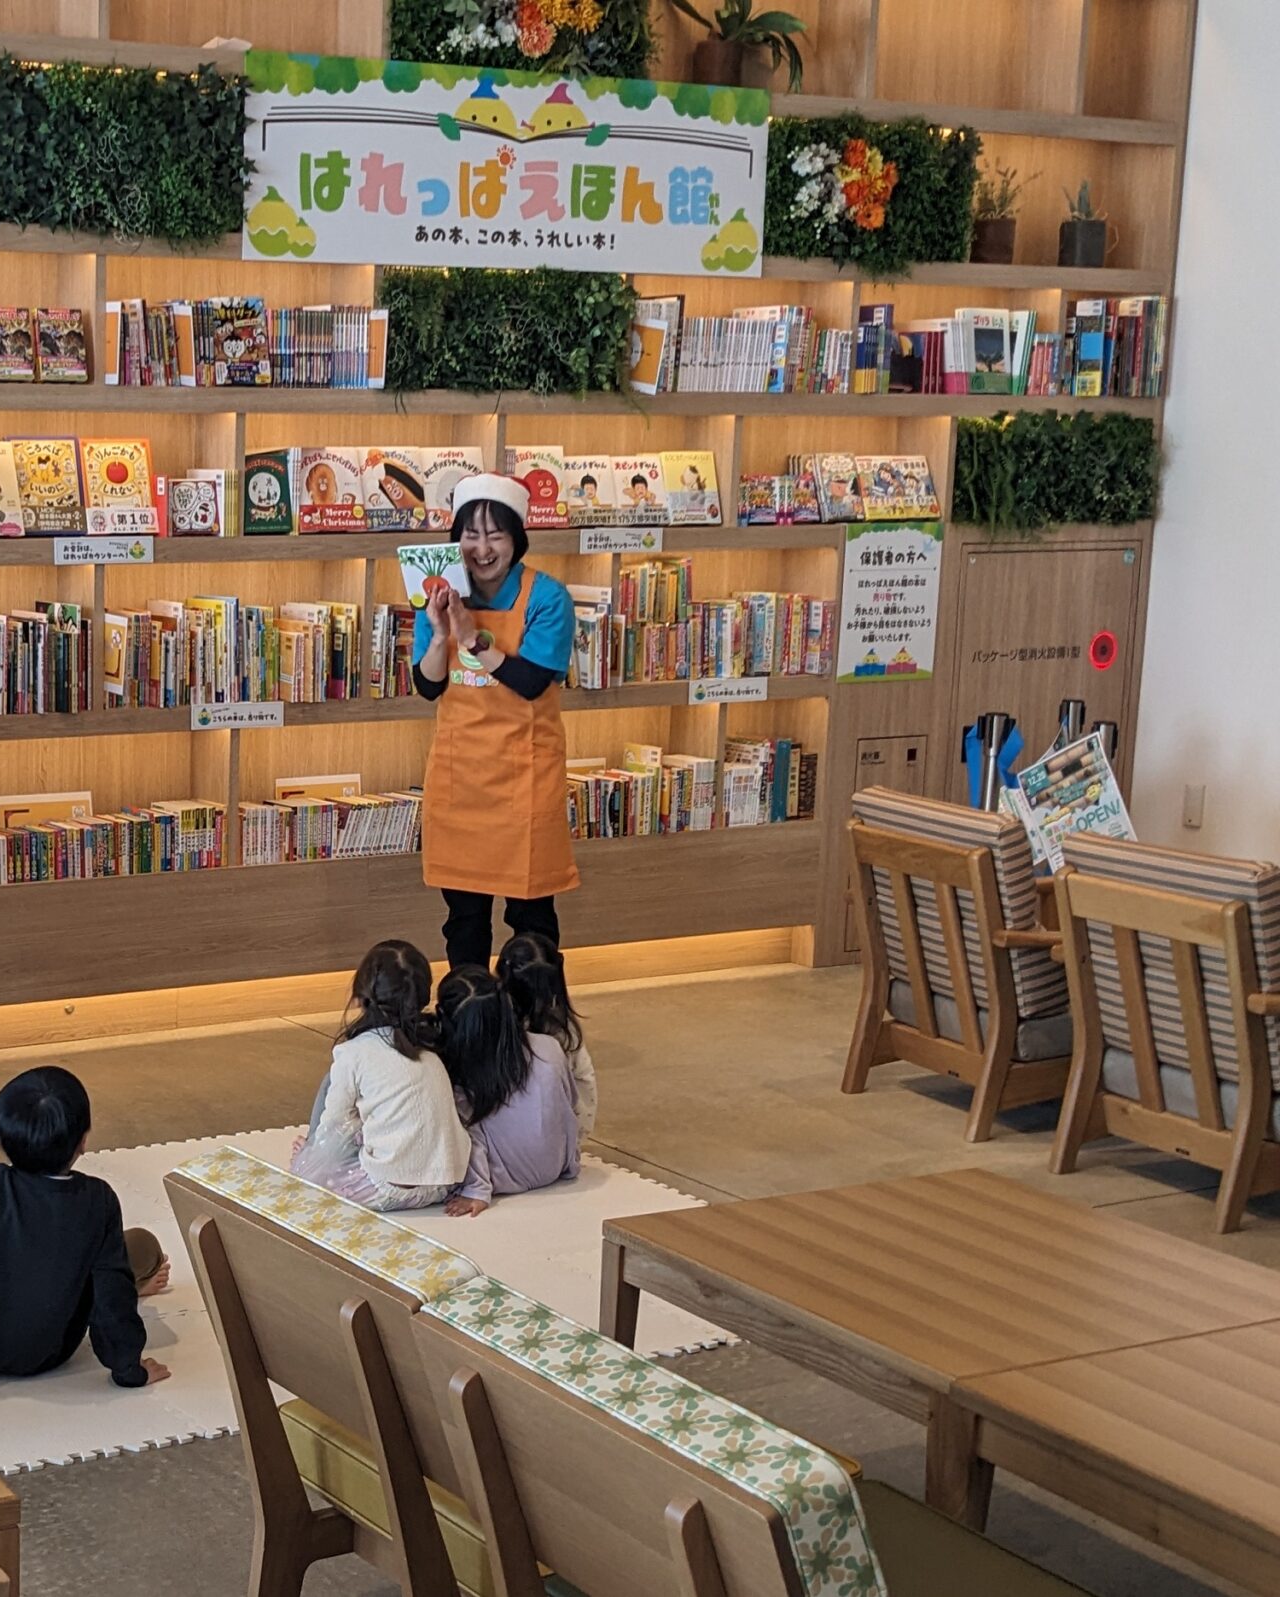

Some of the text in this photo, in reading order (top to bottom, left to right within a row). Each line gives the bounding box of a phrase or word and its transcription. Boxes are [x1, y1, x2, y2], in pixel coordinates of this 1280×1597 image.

[299, 144, 714, 226] はれっぱえほん館
[26, 443, 61, 456] ころべば
[95, 446, 136, 460] りんごかも
[564, 461, 607, 470] 大ピンチずかん
[615, 461, 658, 470] 大ピンチずかん
[30, 483, 65, 494] いいのに
[103, 484, 135, 495] しれない
[325, 508, 352, 517] Merry
[530, 506, 555, 514] Merry
[117, 513, 150, 525] 第1位
[322, 518, 366, 526] Christmas
[528, 516, 568, 524] Christmas
[860, 550, 927, 566] 保護者の方へ
[1076, 799, 1121, 832] OPEN!
